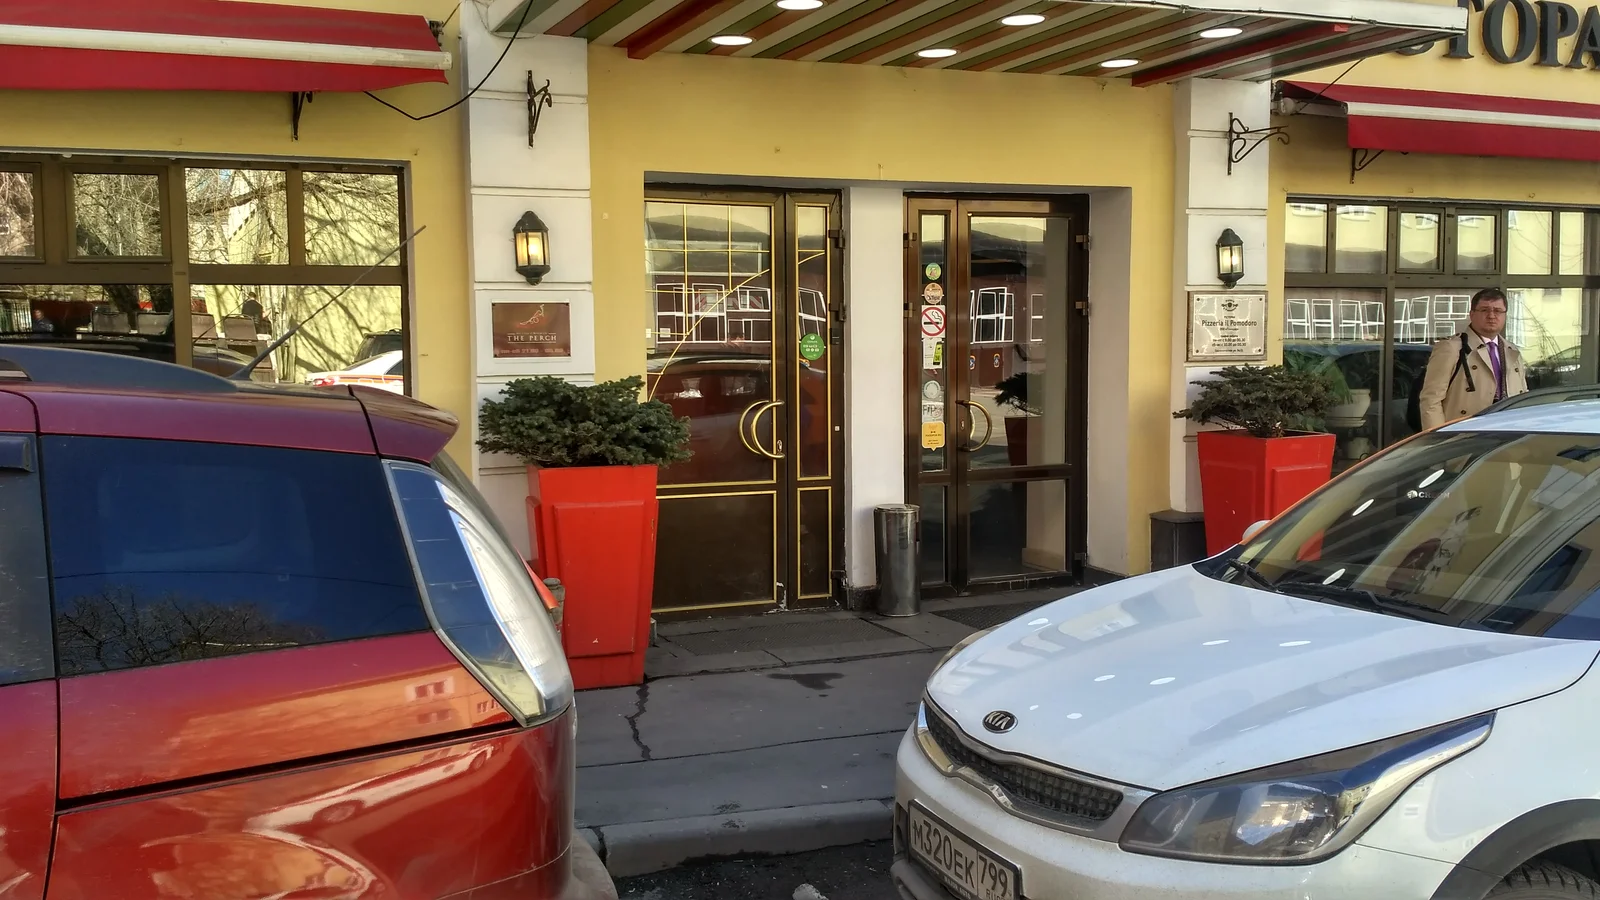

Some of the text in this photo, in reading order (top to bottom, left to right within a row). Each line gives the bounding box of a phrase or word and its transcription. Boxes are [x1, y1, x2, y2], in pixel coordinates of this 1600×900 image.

[985, 711, 1011, 730] KIA
[913, 819, 975, 889] М320ЕК
[978, 855, 1008, 898] 799
